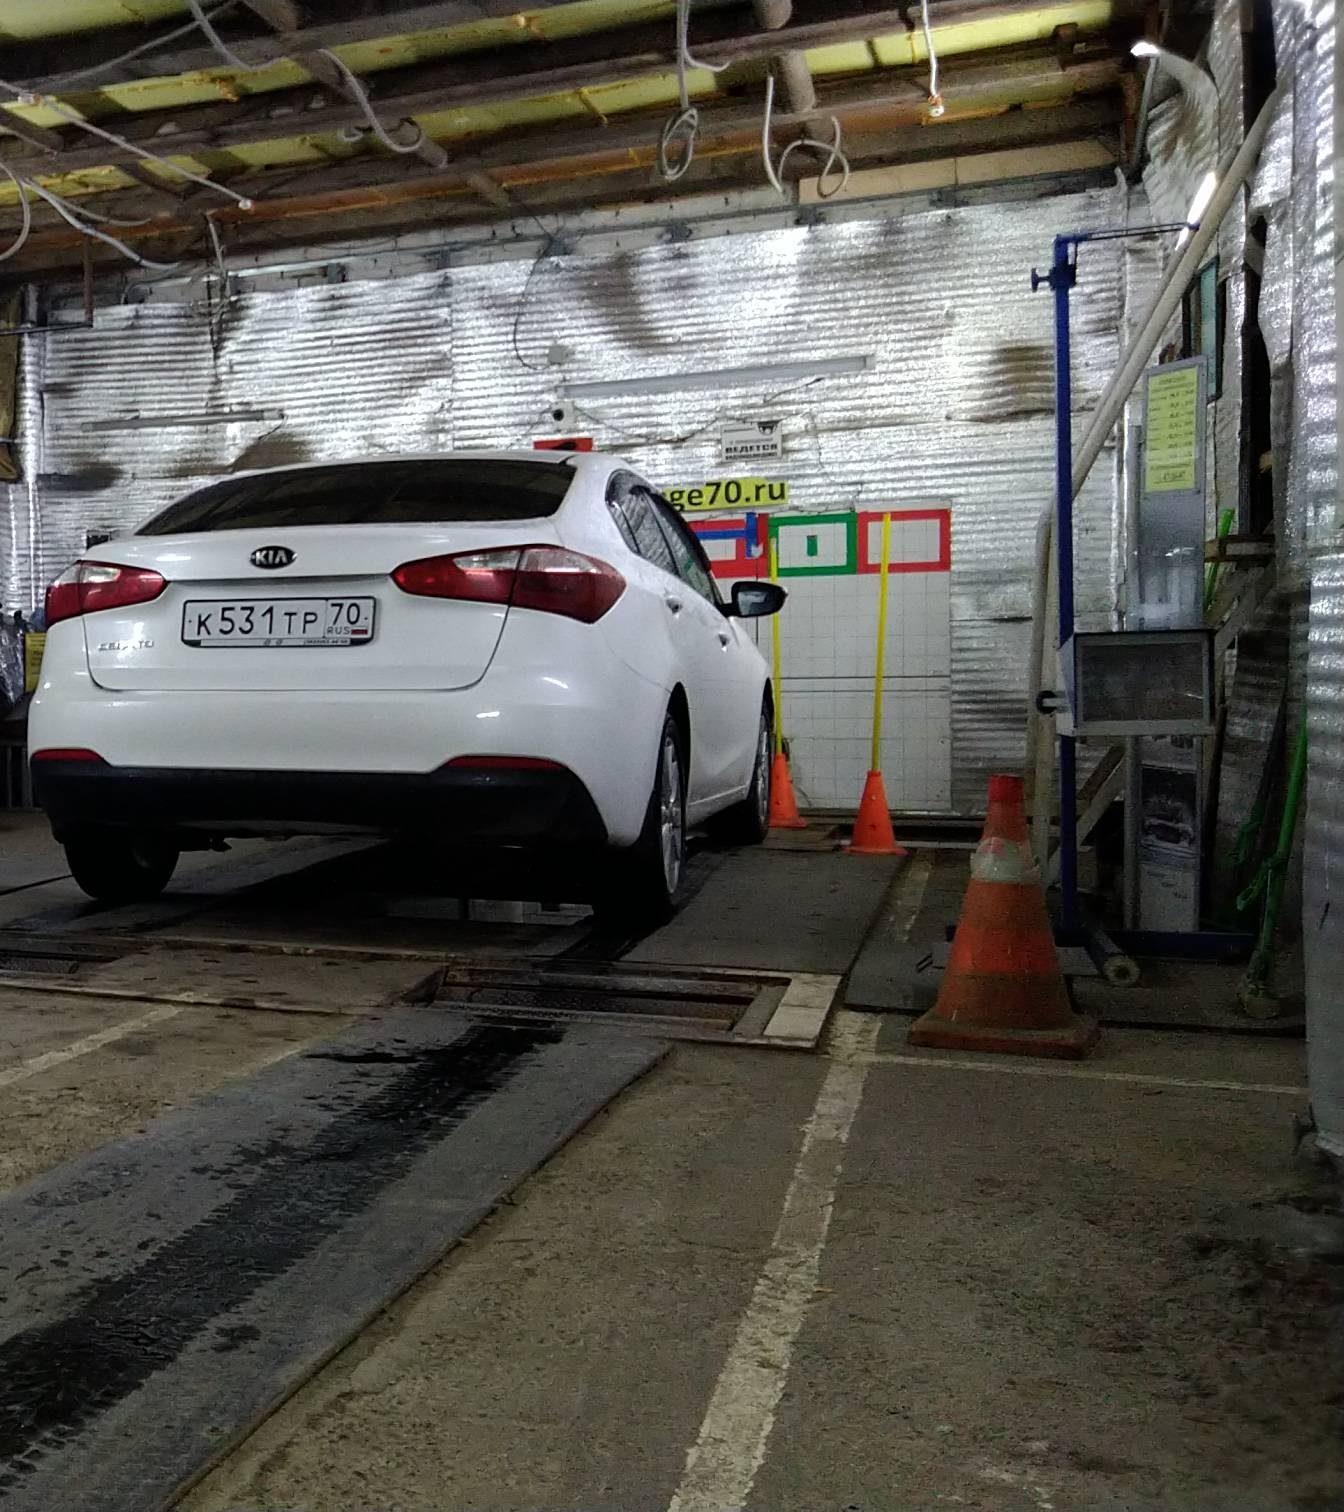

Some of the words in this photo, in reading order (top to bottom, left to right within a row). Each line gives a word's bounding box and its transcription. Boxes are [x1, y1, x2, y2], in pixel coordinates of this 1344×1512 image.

[662, 480, 786, 513] ge70.ru
[256, 550, 288, 565] KIA
[330, 603, 361, 626] 70
[326, 626, 351, 636] RUS
